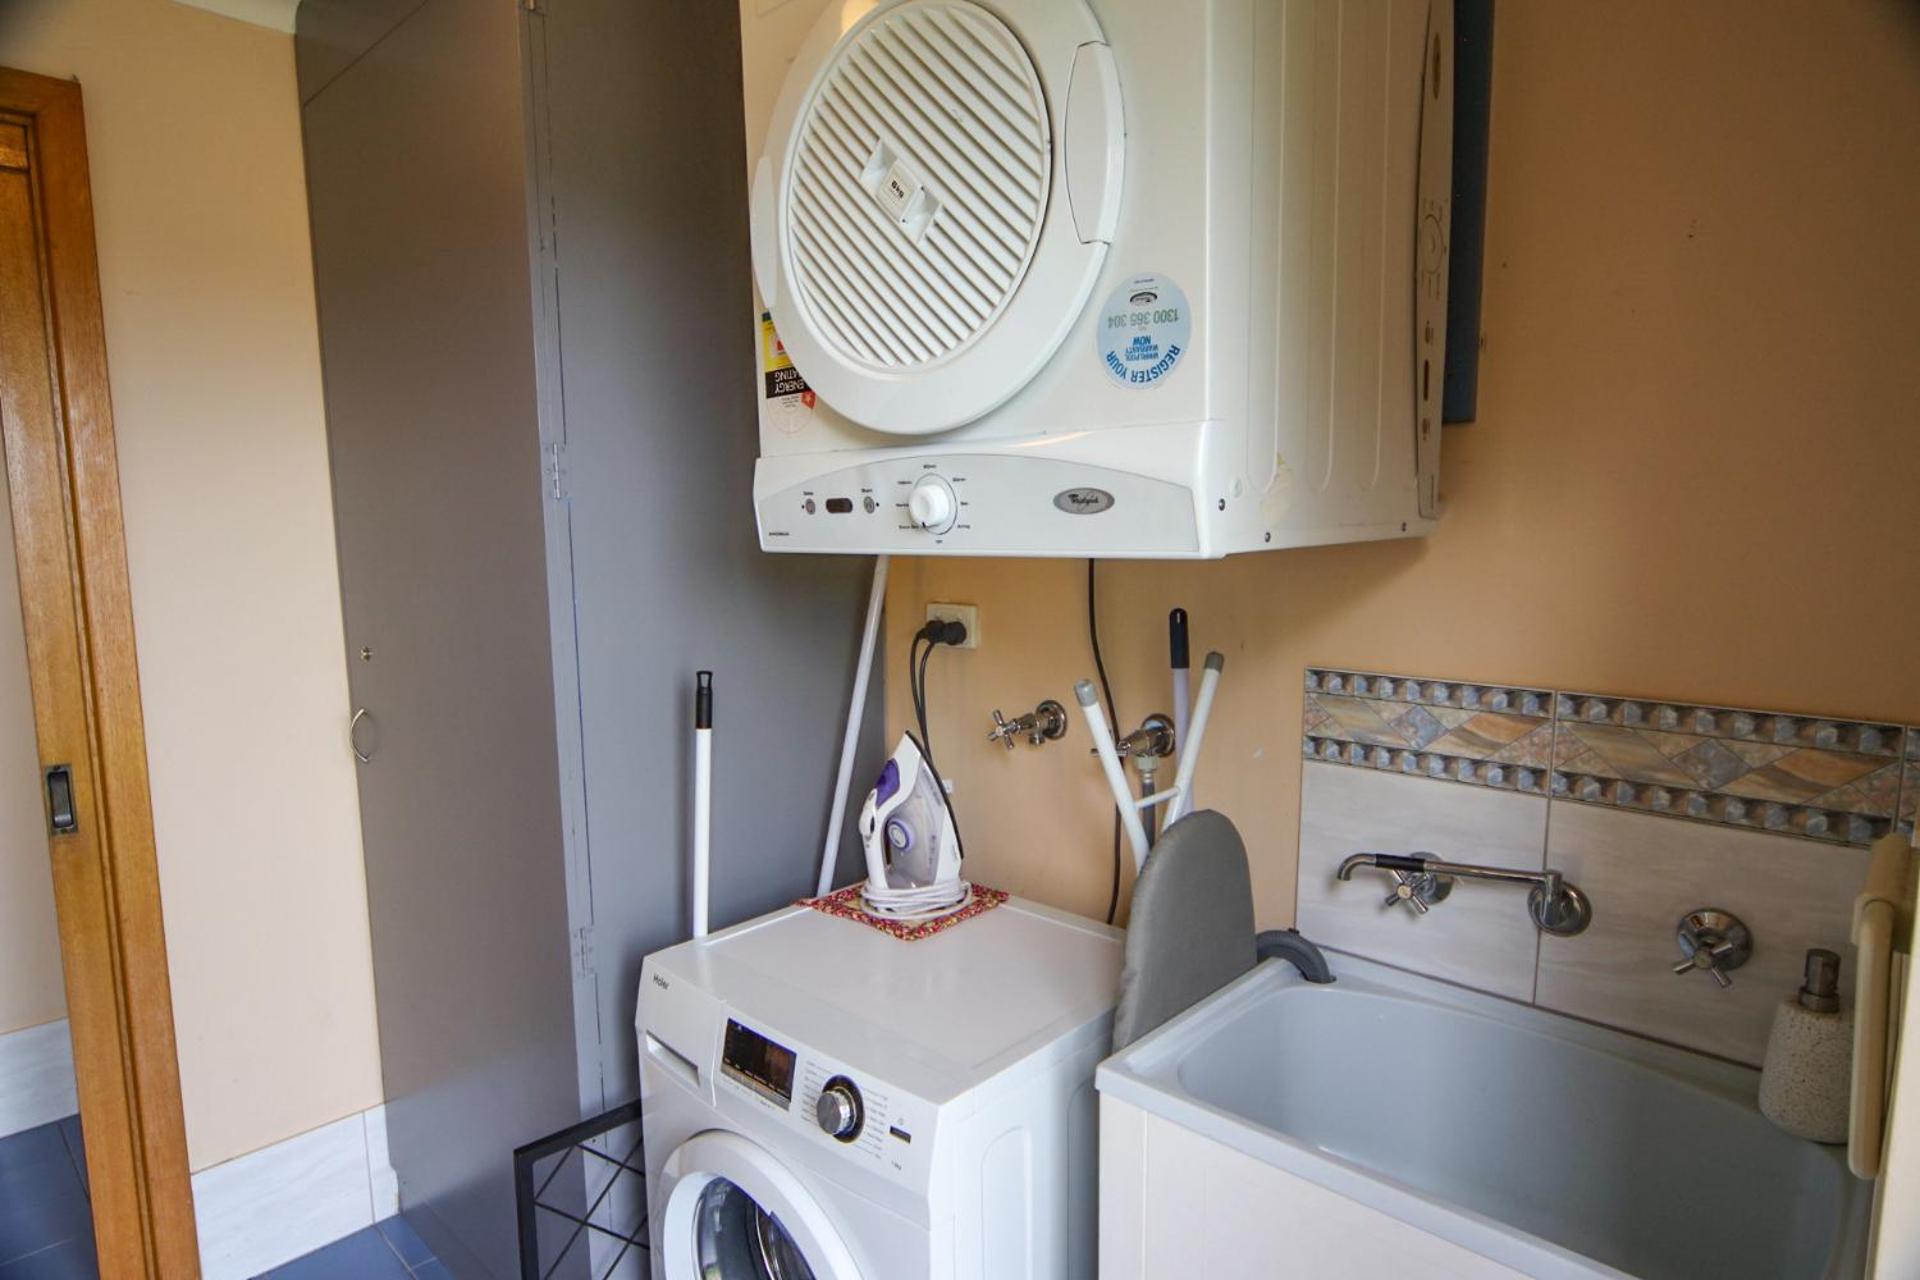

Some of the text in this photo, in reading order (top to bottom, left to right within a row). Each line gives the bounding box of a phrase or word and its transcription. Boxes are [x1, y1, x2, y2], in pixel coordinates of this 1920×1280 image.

[1107, 308, 1179, 329] 1300 365 304
[1132, 335, 1151, 345] NOW
[1106, 344, 1180, 383] REGISTER YOUR
[774, 368, 800, 382] ATING
[775, 379, 805, 393] ENERGY
